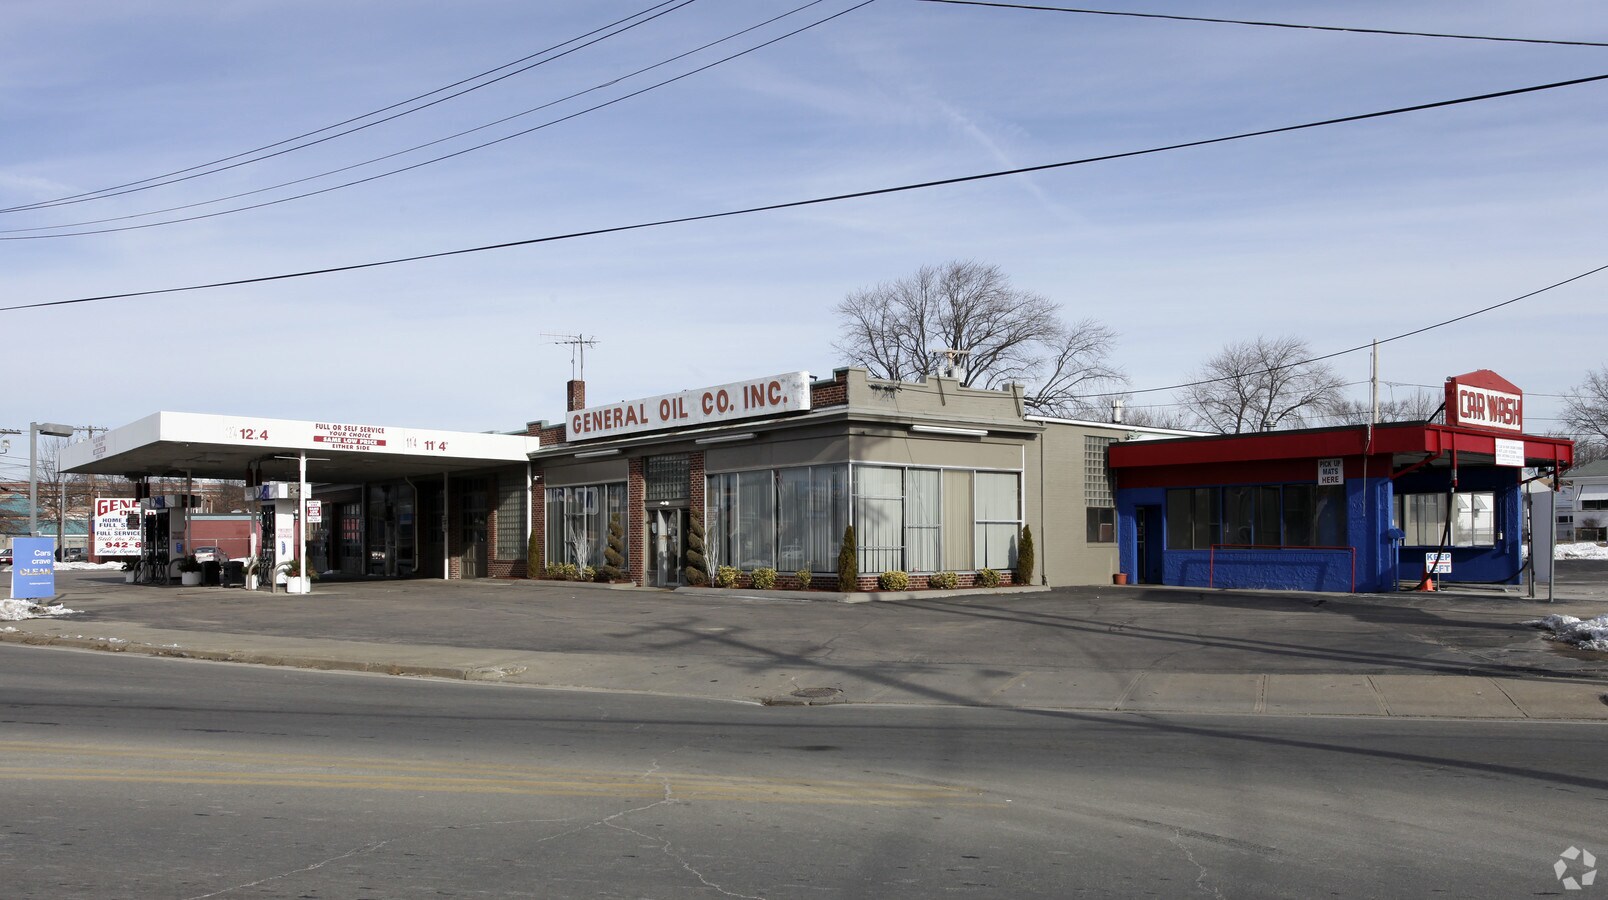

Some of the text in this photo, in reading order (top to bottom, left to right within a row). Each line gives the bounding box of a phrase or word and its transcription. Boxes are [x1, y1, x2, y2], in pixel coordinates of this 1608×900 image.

[572, 380, 788, 434] GENERAL OIL CO. INC.
[1460, 390, 1520, 426] CAR WASH
[360, 426, 385, 434] SERVICE
[1319, 459, 1341, 468] PICK UP
[1322, 476, 1339, 484] HERE
[34, 549, 51, 557] Cars
[1427, 553, 1450, 561] KEEP
[19, 568, 53, 576] CLEAN.
